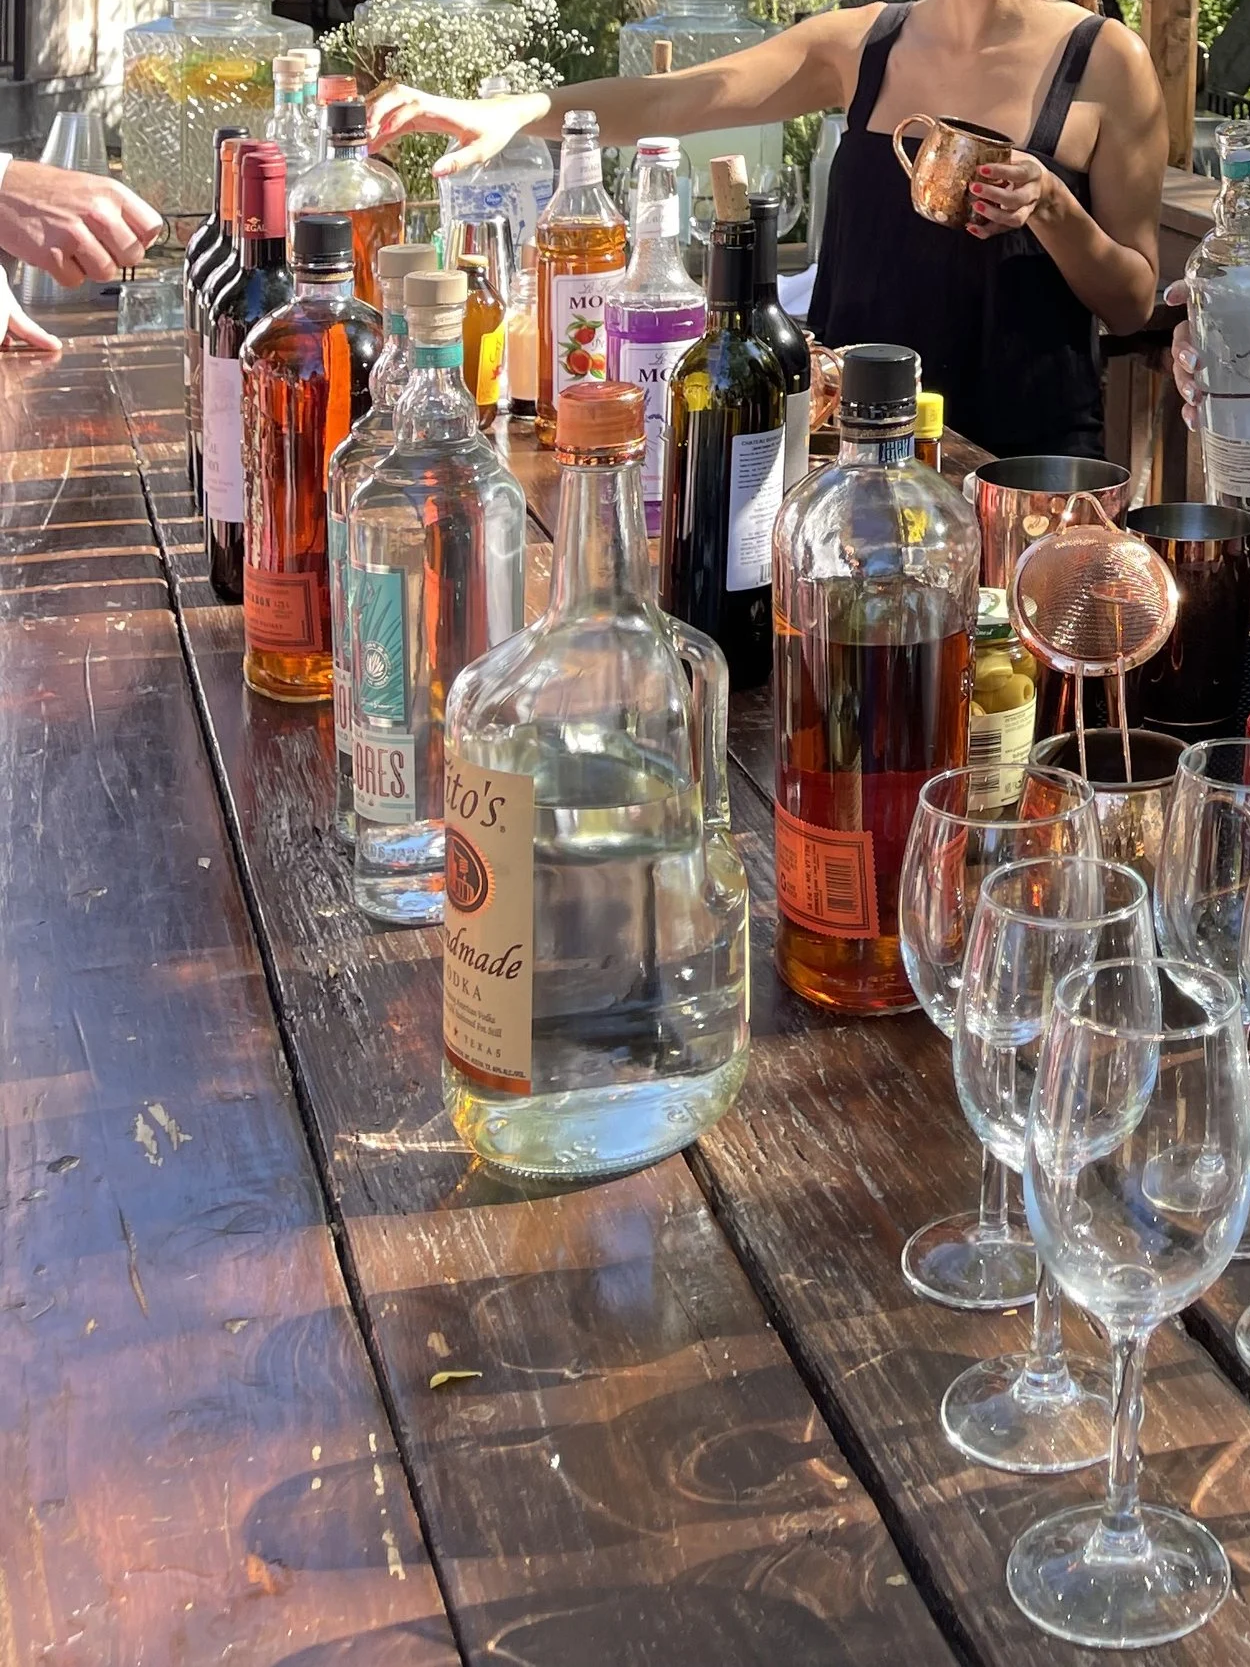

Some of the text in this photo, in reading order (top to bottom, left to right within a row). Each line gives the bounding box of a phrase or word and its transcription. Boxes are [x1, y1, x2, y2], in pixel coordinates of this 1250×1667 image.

[444, 758, 506, 827] ito's
[444, 927, 524, 980] ndmade
[446, 963, 482, 1002] ODKA
[464, 1034, 501, 1059] TEXAS
